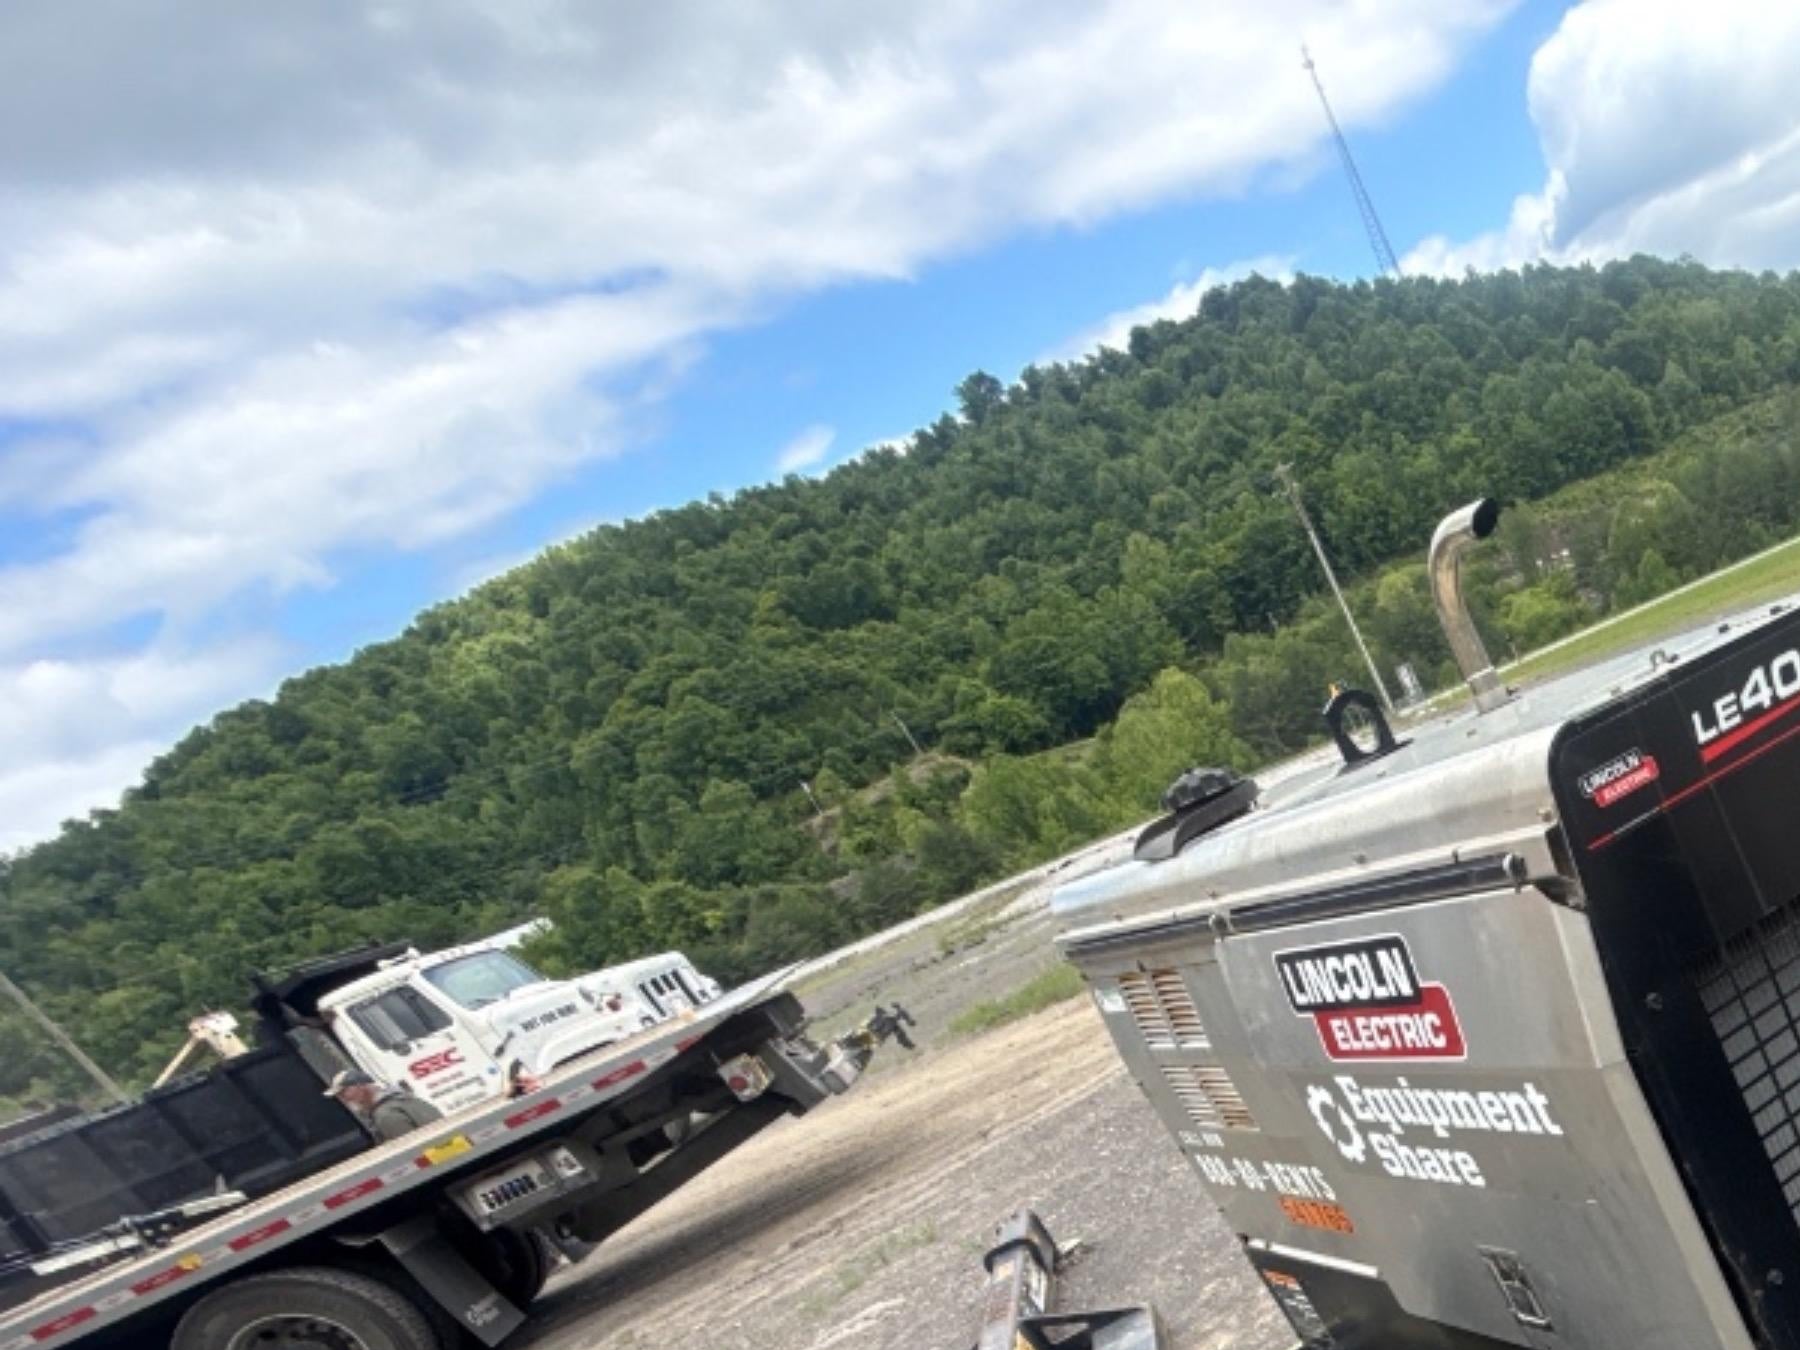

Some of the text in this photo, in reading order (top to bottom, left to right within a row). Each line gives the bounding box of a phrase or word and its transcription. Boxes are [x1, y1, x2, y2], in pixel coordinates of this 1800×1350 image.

[1282, 947, 1413, 1005] LINCOLN
[1329, 1012, 1447, 1050] ELECTRIC
[1334, 1075, 1564, 1138] Equipment
[1367, 1131, 1486, 1188] Share
